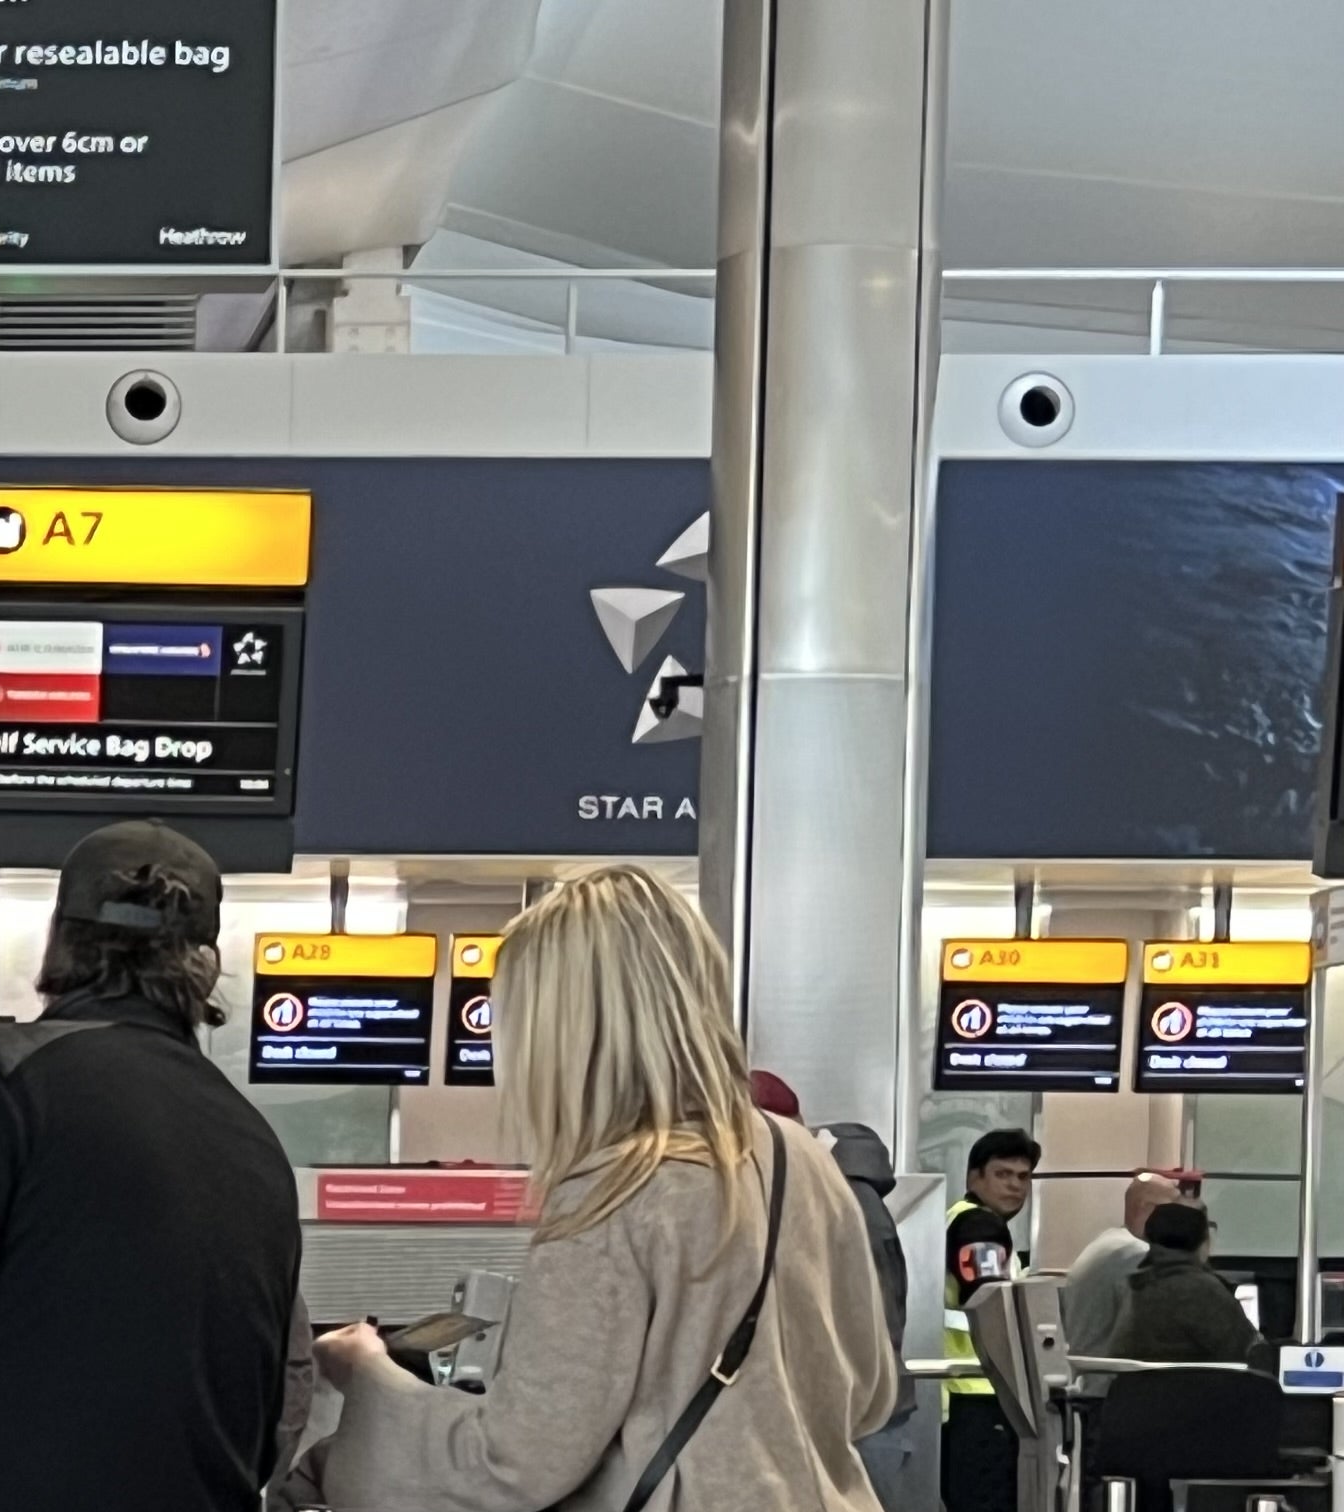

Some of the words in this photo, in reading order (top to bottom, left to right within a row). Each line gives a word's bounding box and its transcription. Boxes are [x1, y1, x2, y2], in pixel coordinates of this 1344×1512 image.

[15, 40, 166, 67] resealable
[174, 41, 230, 73] bag
[62, 132, 114, 155] 6cm
[119, 135, 148, 155] or
[5, 159, 76, 184] items
[158, 227, 247, 246] Heathrow
[42, 511, 104, 546] A7
[22, 733, 101, 755] Service
[106, 735, 150, 762] Bag
[154, 736, 212, 763] Drop
[578, 796, 663, 820] STAR
[674, 797, 697, 820] A
